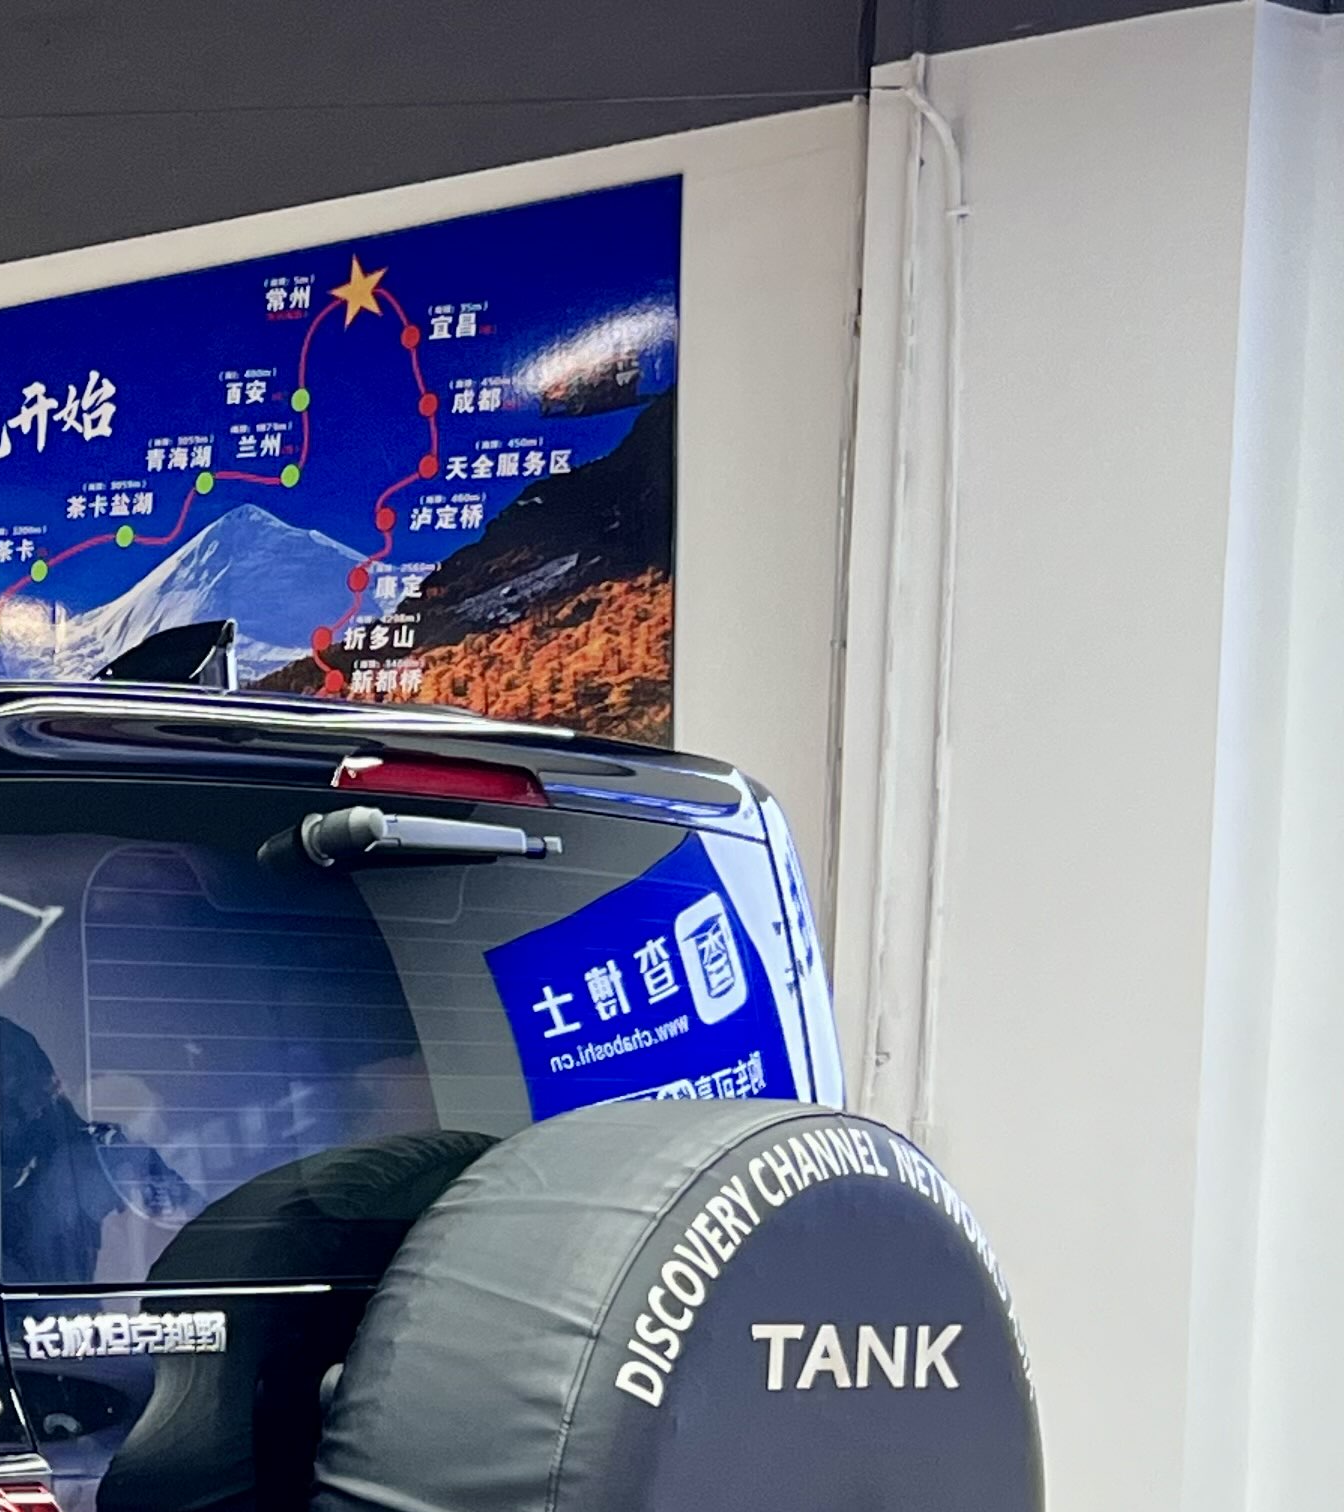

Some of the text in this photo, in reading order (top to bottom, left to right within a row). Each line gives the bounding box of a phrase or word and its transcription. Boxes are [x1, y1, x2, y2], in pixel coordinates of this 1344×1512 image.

[265, 284, 311, 312] 常州
[428, 312, 477, 341] 宜昌
[451, 387, 503, 414] 成都
[144, 445, 213, 473] 青海湖
[235, 432, 282, 459] 兰州
[444, 448, 573, 481] 天全服务区
[66, 491, 154, 520] 茶卡盐湖
[409, 503, 484, 532] 泸定桥
[374, 573, 424, 599] 康定
[343, 624, 415, 652] 折多山
[350, 668, 423, 694] 新都桥
[615, 1178, 763, 1407] DISCOVERY
[748, 1126, 889, 1206] CHANNEL
[22, 1310, 228, 1361] 长城坦克越野
[751, 1323, 964, 1391] TANK
